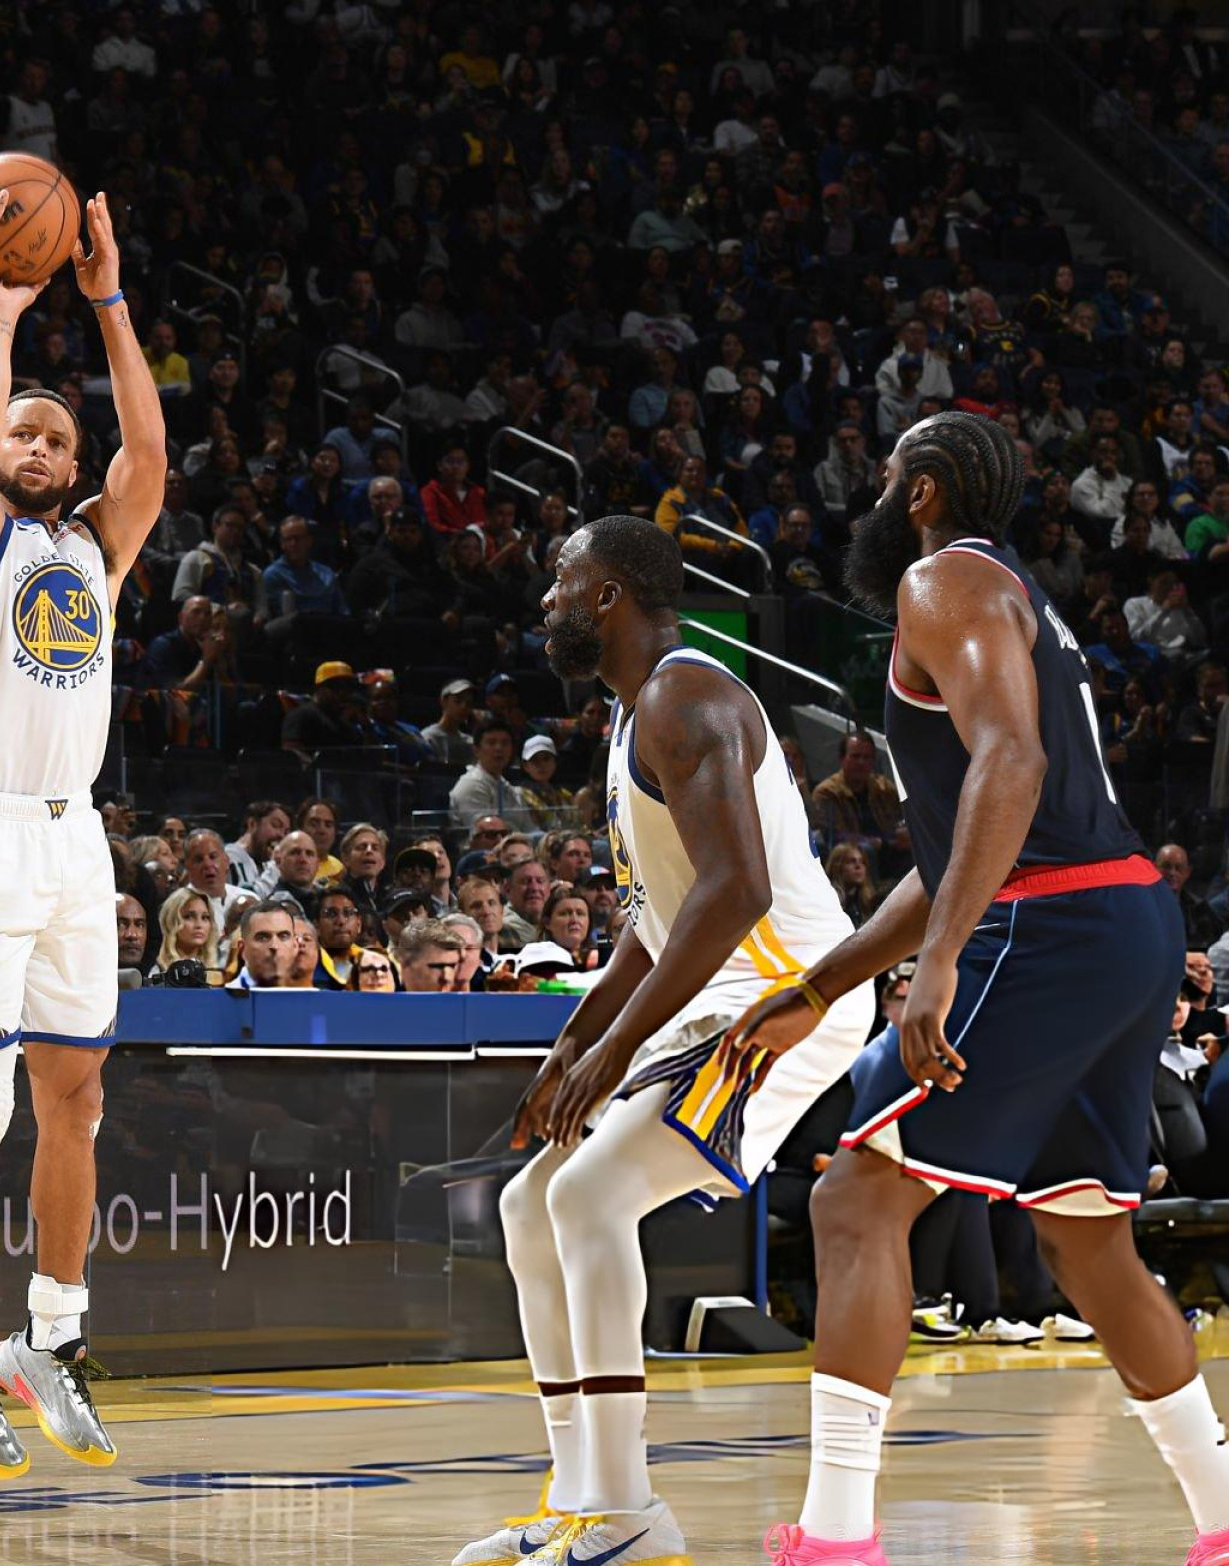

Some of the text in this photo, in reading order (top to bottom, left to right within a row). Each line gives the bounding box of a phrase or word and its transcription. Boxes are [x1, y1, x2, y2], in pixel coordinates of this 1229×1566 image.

[14, 552, 67, 584] GOLDE
[64, 589, 91, 621] 30
[12, 647, 105, 690] WARRIORS
